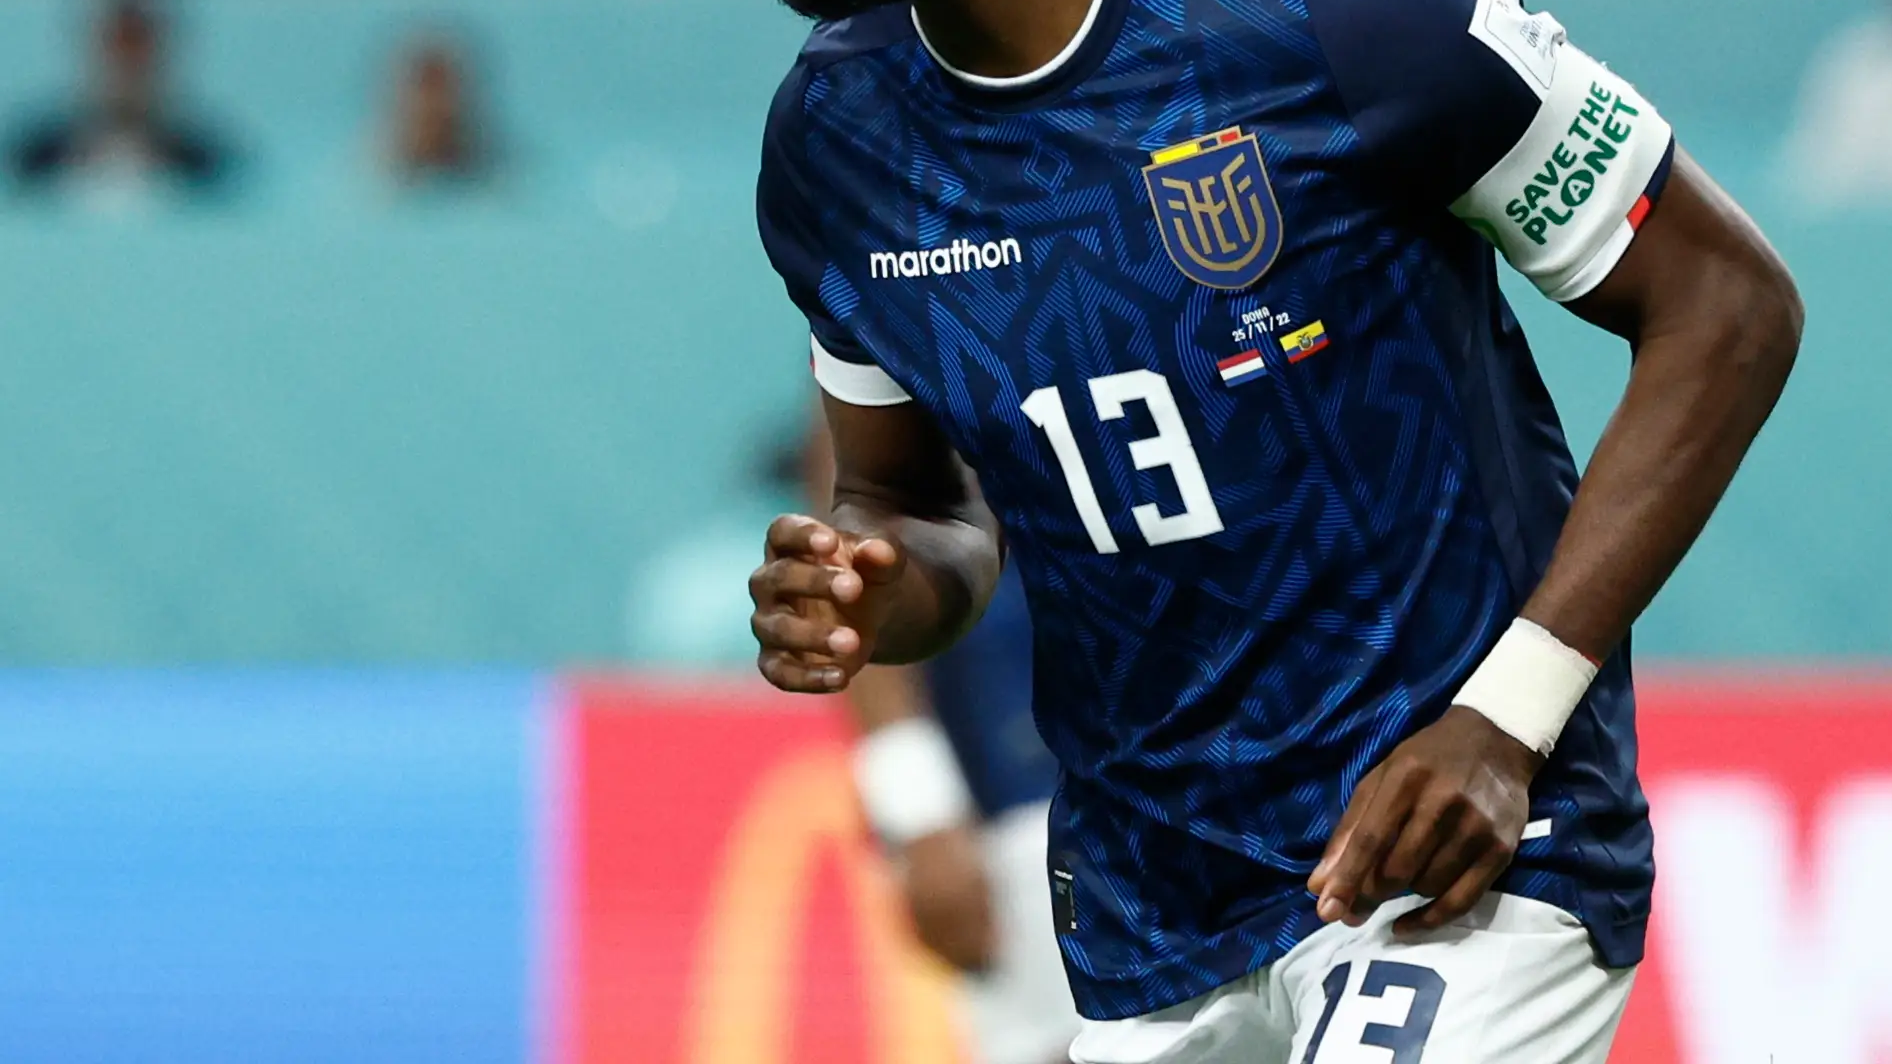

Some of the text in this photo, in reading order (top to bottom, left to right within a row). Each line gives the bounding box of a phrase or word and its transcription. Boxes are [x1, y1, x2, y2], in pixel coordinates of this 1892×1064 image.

[1505, 81, 1612, 225] SAVE THE
[1522, 95, 1640, 246] PLANET
[870, 238, 1022, 278] marathon
[1241, 306, 1270, 325] DOHA
[1020, 369, 1225, 554] 13
[1301, 959, 1447, 1064] 13
